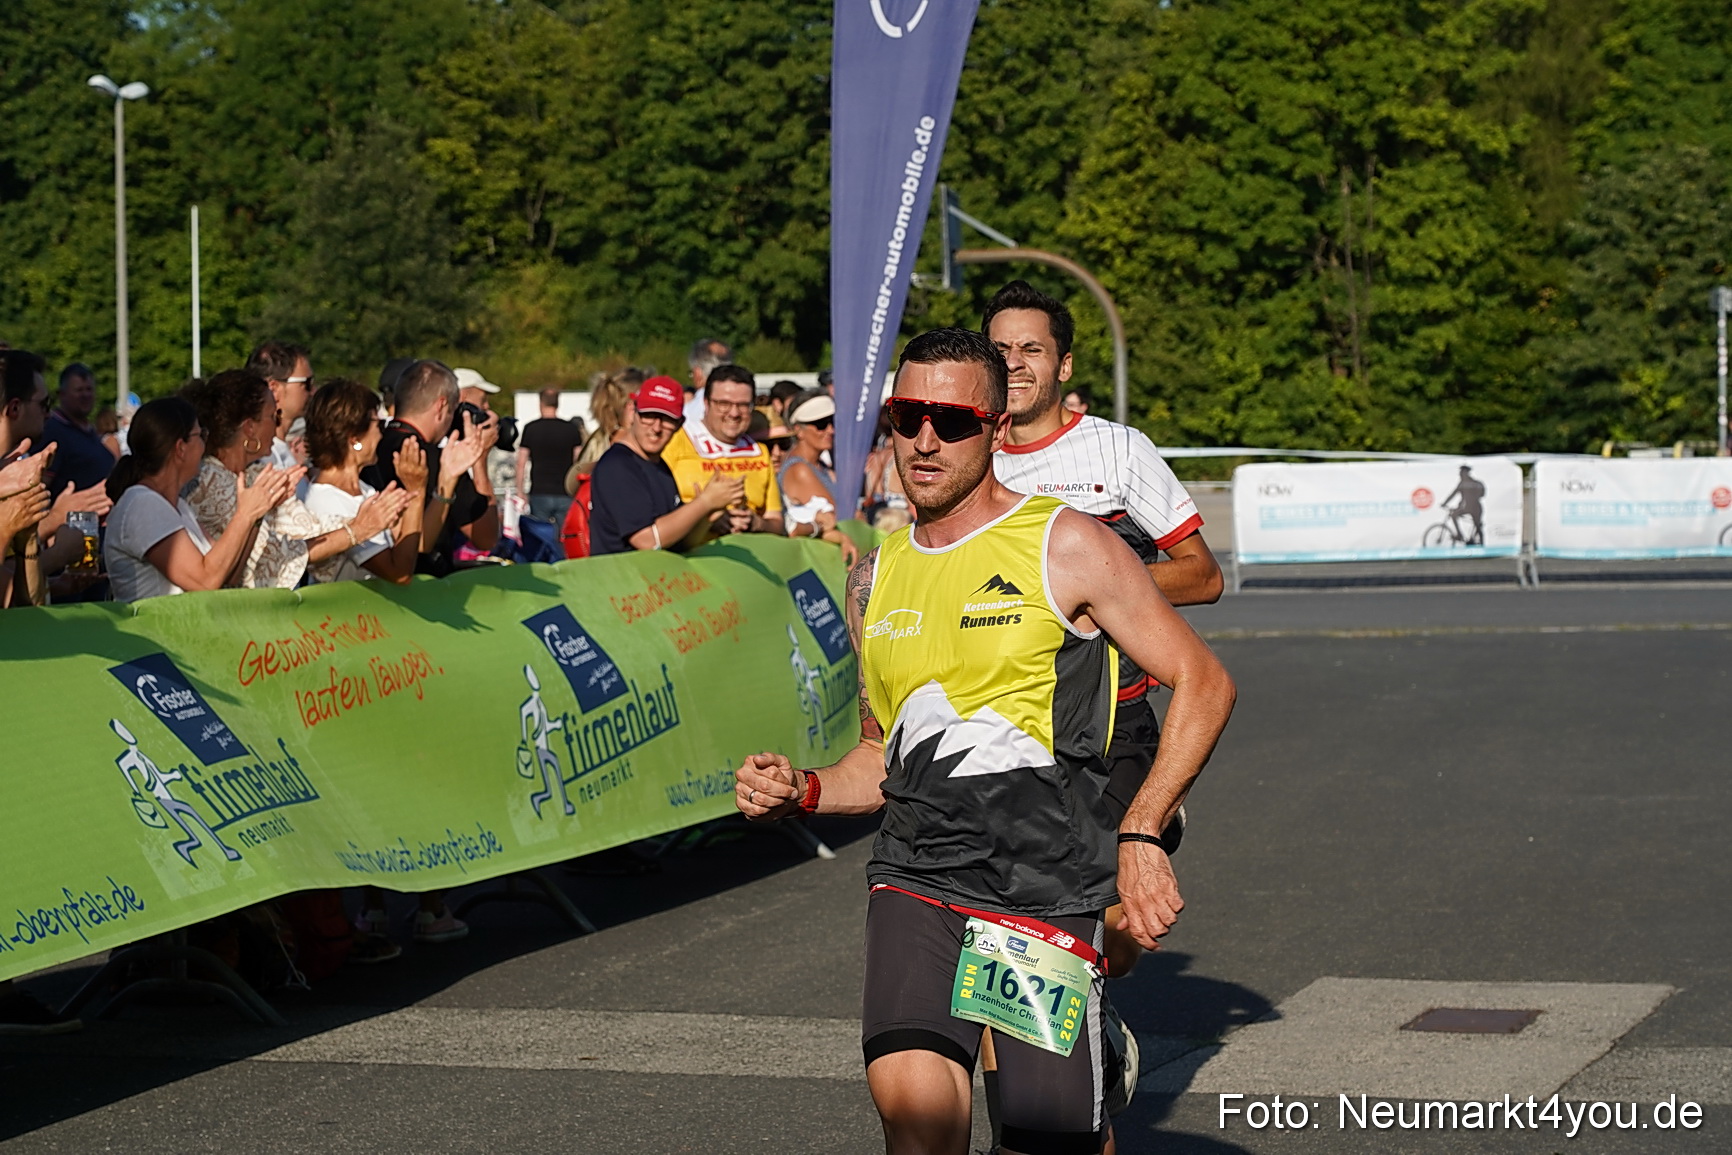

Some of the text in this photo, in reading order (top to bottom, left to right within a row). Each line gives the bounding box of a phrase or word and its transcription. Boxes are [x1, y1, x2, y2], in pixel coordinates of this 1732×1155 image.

[856, 115, 936, 422] www.fischer-automobile.de
[1037, 483, 1092, 493] NEUMARKT
[959, 613, 1023, 630] Runners
[963, 599, 1024, 613] Kettenbach
[238, 619, 336, 687] Gesunde
[889, 625, 923, 640] MARX
[152, 687, 197, 711] Fischer
[295, 666, 372, 729] laufen
[562, 663, 680, 777] firmenlauf
[178, 737, 319, 823] firmenlauf
[579, 758, 634, 804] neumarkt
[238, 811, 295, 848] neumarkt
[0, 876, 144, 953] -oberpfalz.de
[999, 918, 1045, 939] new balance
[960, 964, 978, 999] RUN
[982, 960, 1066, 1017] 1621
[972, 990, 1018, 1015] Inzenhofer
[1060, 996, 1081, 1042] 2022
